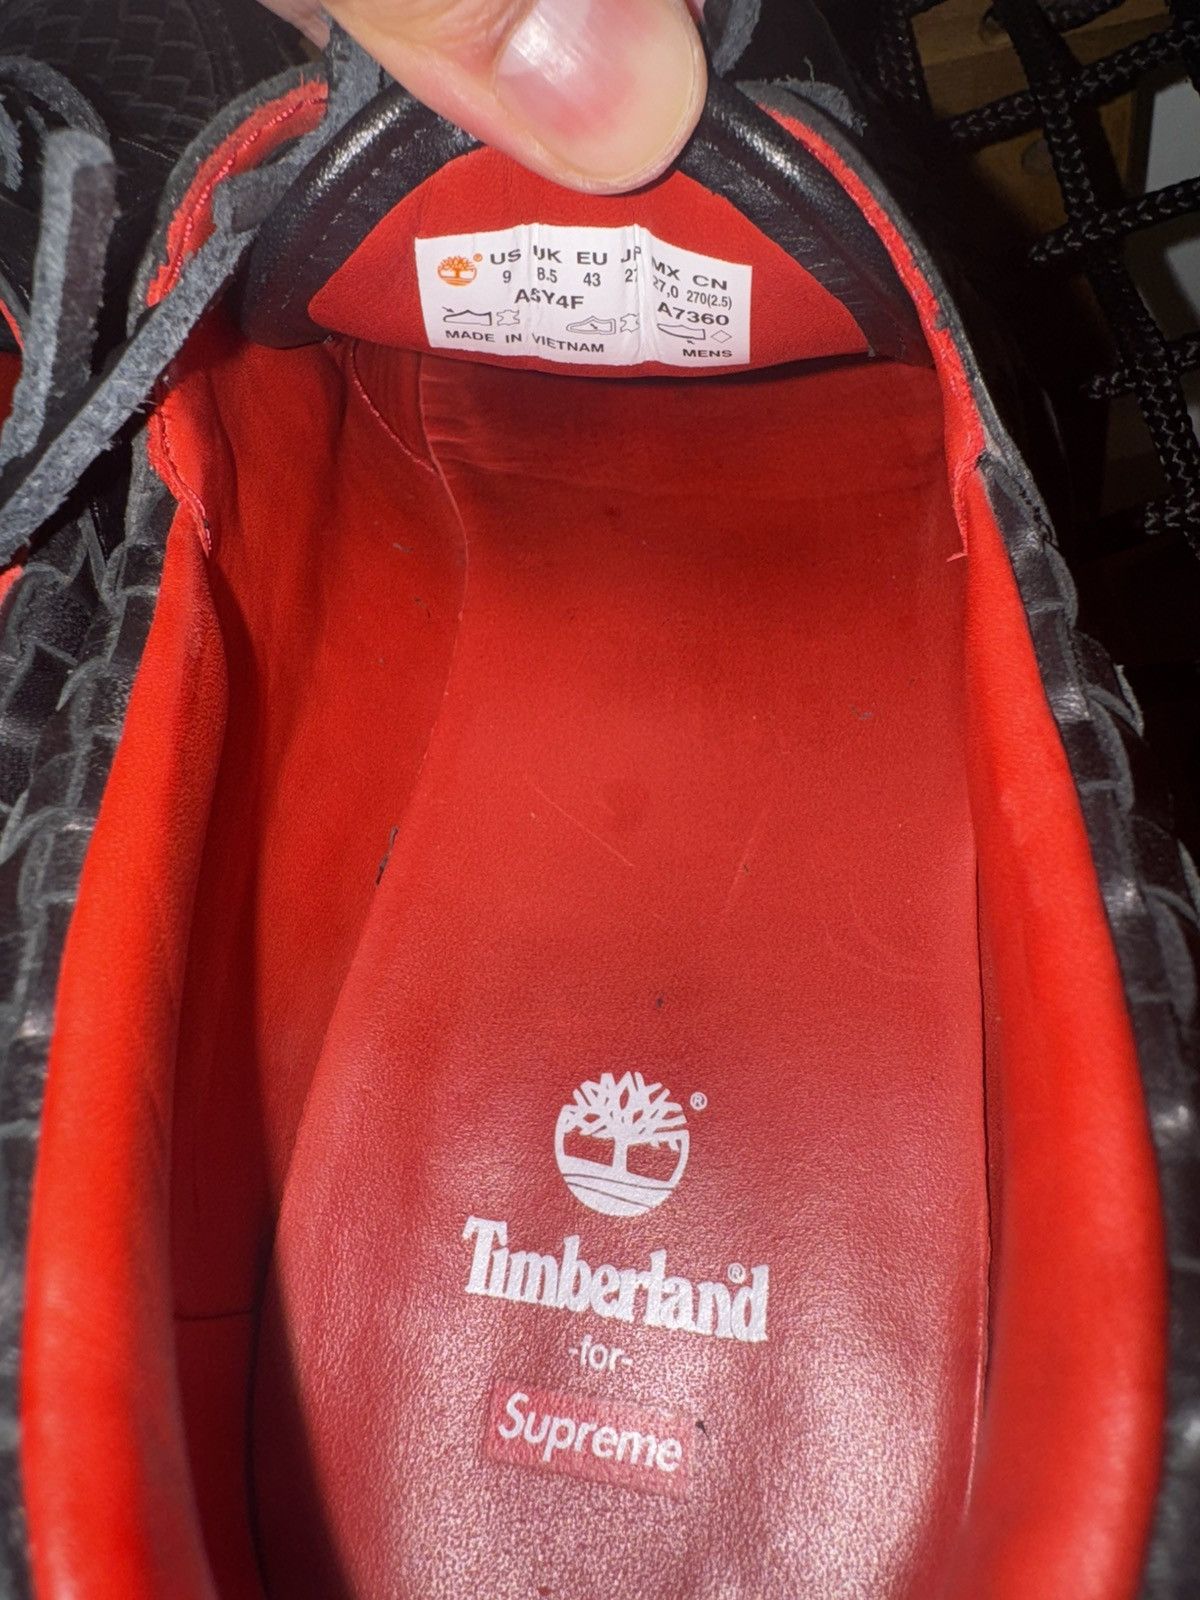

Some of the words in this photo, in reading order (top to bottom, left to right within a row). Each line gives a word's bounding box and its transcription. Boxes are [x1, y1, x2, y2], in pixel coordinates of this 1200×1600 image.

[490, 248, 521, 265] US
[533, 245, 562, 264] UK
[577, 251, 608, 265] EU
[621, 246, 641, 263] JP
[651, 256, 680, 280] MX
[692, 274, 727, 290] CN
[502, 270, 512, 283] 9
[537, 266, 558, 284] 8.5
[583, 272, 601, 287] 43
[686, 289, 733, 310] 270(2.5)
[657, 301, 729, 326] A7360
[445, 329, 495, 343] MADE
[505, 333, 522, 343] IN
[531, 333, 605, 353] VIETNAM
[682, 348, 732, 358] MENS
[498, 1391, 683, 1472] Supreme
